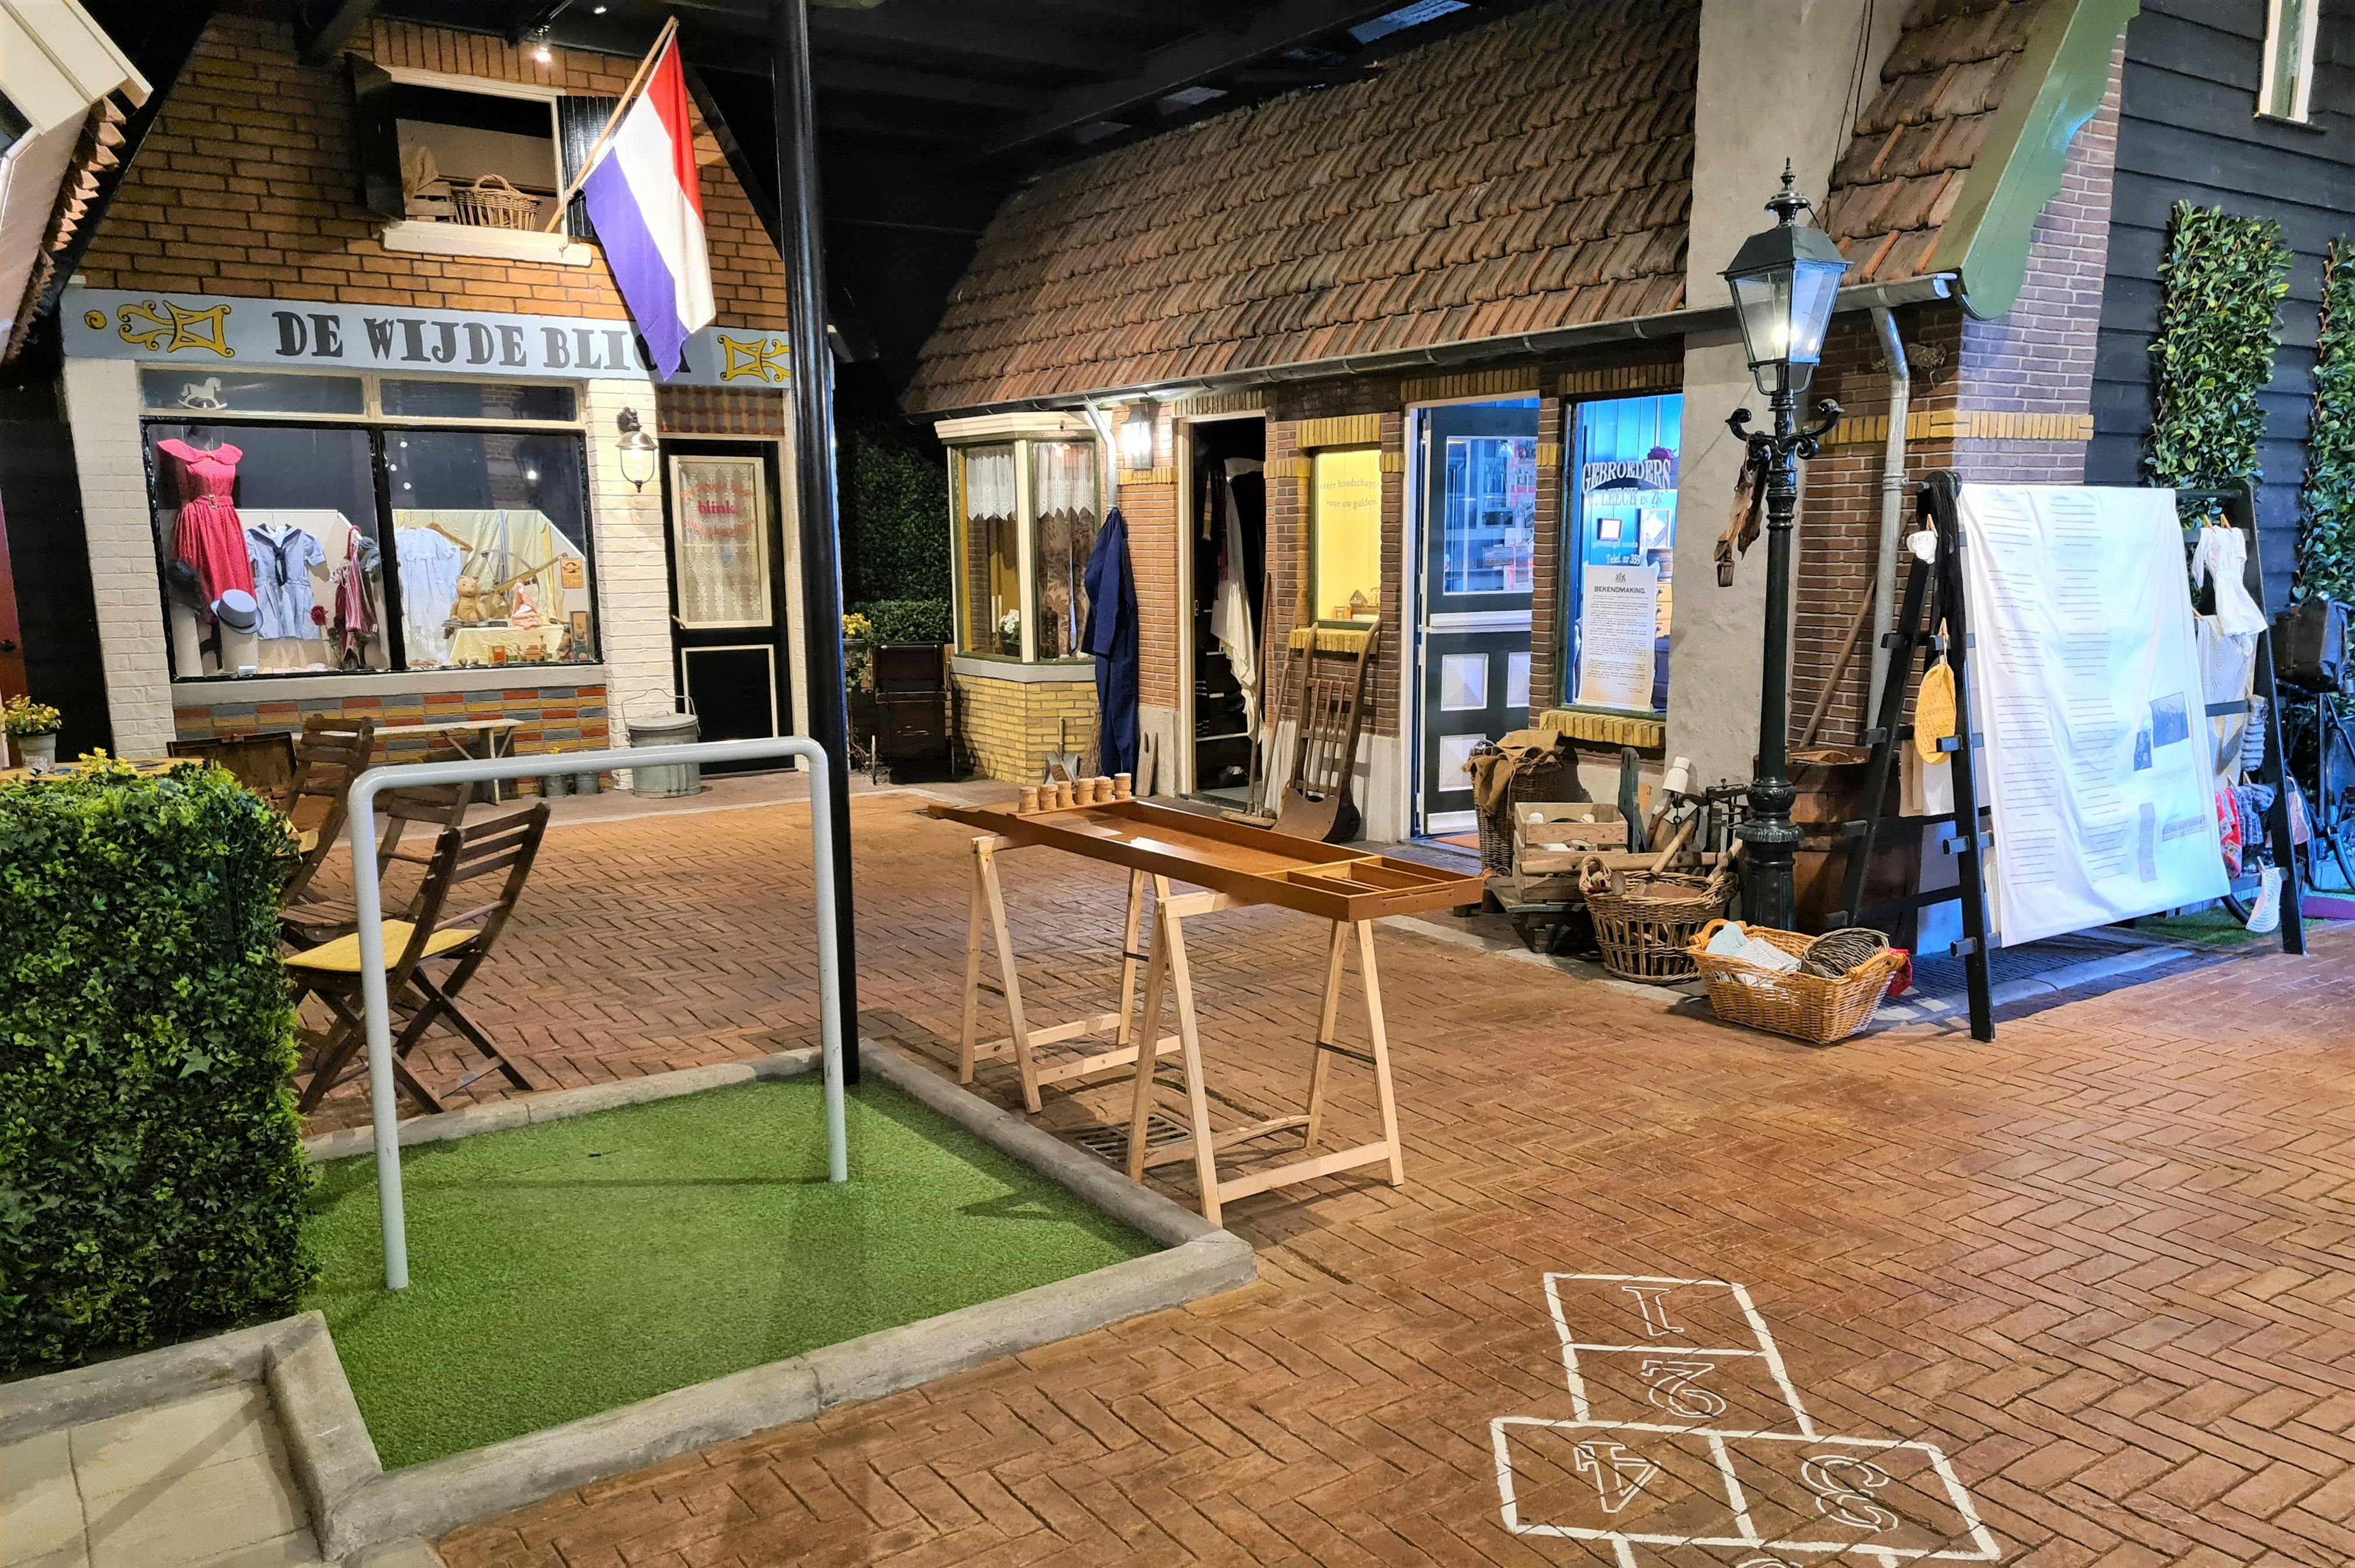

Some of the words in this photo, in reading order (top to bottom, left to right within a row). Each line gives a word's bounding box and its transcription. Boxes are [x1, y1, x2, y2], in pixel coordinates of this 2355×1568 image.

[272, 311, 343, 358] DE
[363, 318, 527, 367] WIJDE
[540, 326, 692, 373] BLI
[1582, 458, 1671, 495] GEBROEDERS
[1325, 499, 1340, 507] voor
[1353, 498, 1378, 510] gulden.
[1600, 487, 1638, 506] LEECK
[1623, 555, 1630, 563] nr
[1630, 554, 1641, 565] 359
[1594, 586, 1646, 594] BEKENDMAKING.
[1640, 1358, 1727, 1419] 2
[1572, 1440, 1662, 1514] 4
